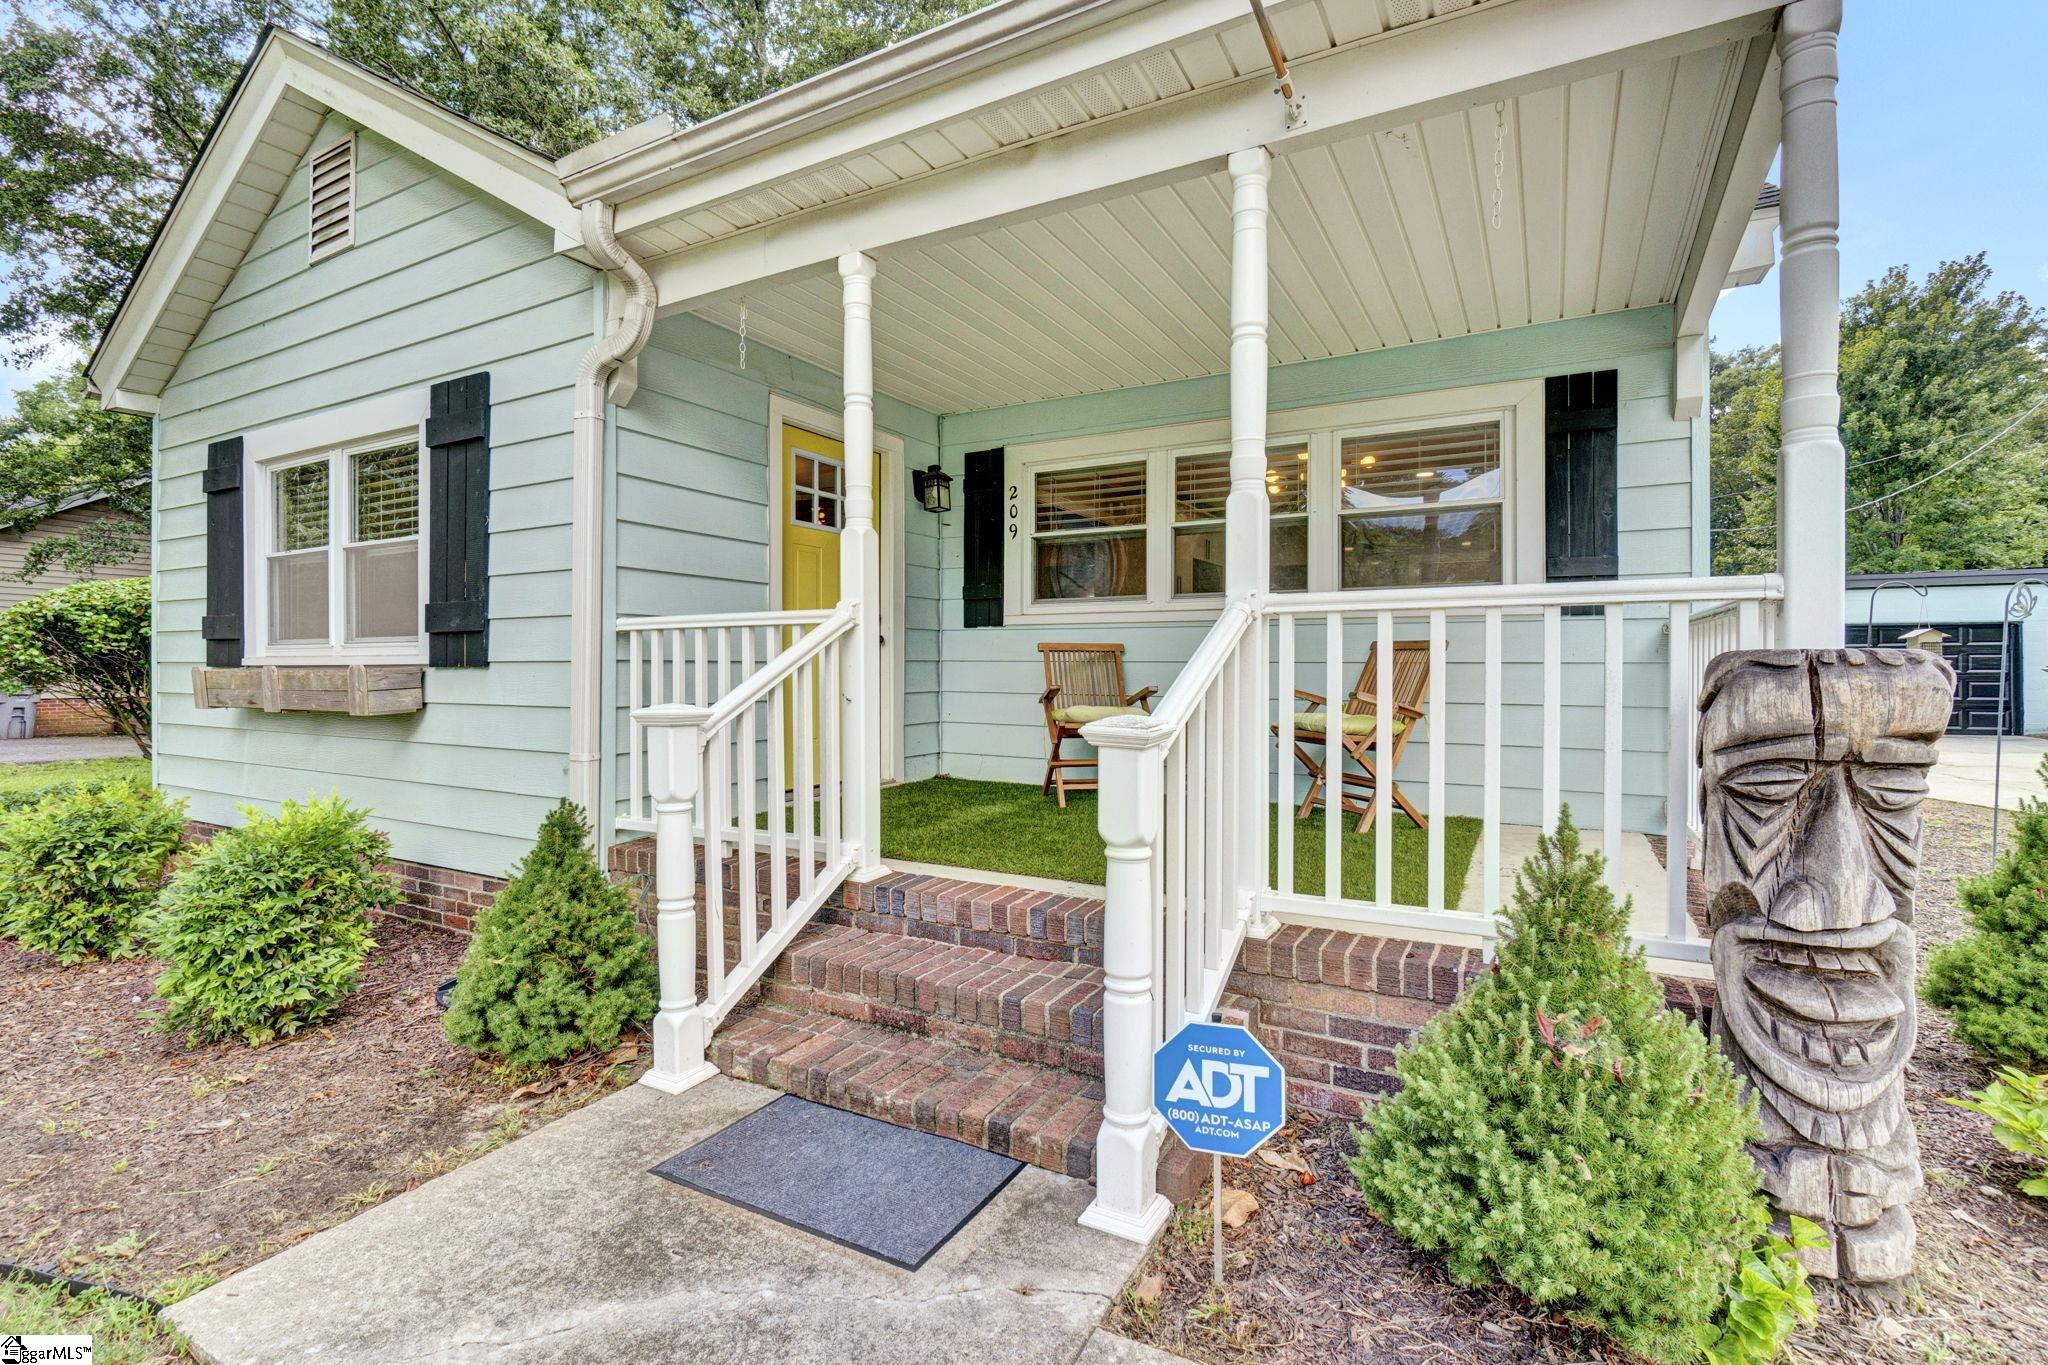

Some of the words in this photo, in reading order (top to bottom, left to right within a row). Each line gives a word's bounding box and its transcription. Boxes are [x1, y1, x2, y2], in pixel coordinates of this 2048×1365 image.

[1008, 485, 1019, 540] 209
[1187, 1043, 1231, 1056] SECURED
[1233, 1049, 1246, 1057] BY
[1165, 1057, 1270, 1114] ADT
[1167, 1107, 1199, 1123] (800)
[1201, 1113, 1271, 1132] ADT-ASAP
[1194, 1125, 1240, 1139] ADT.COM
